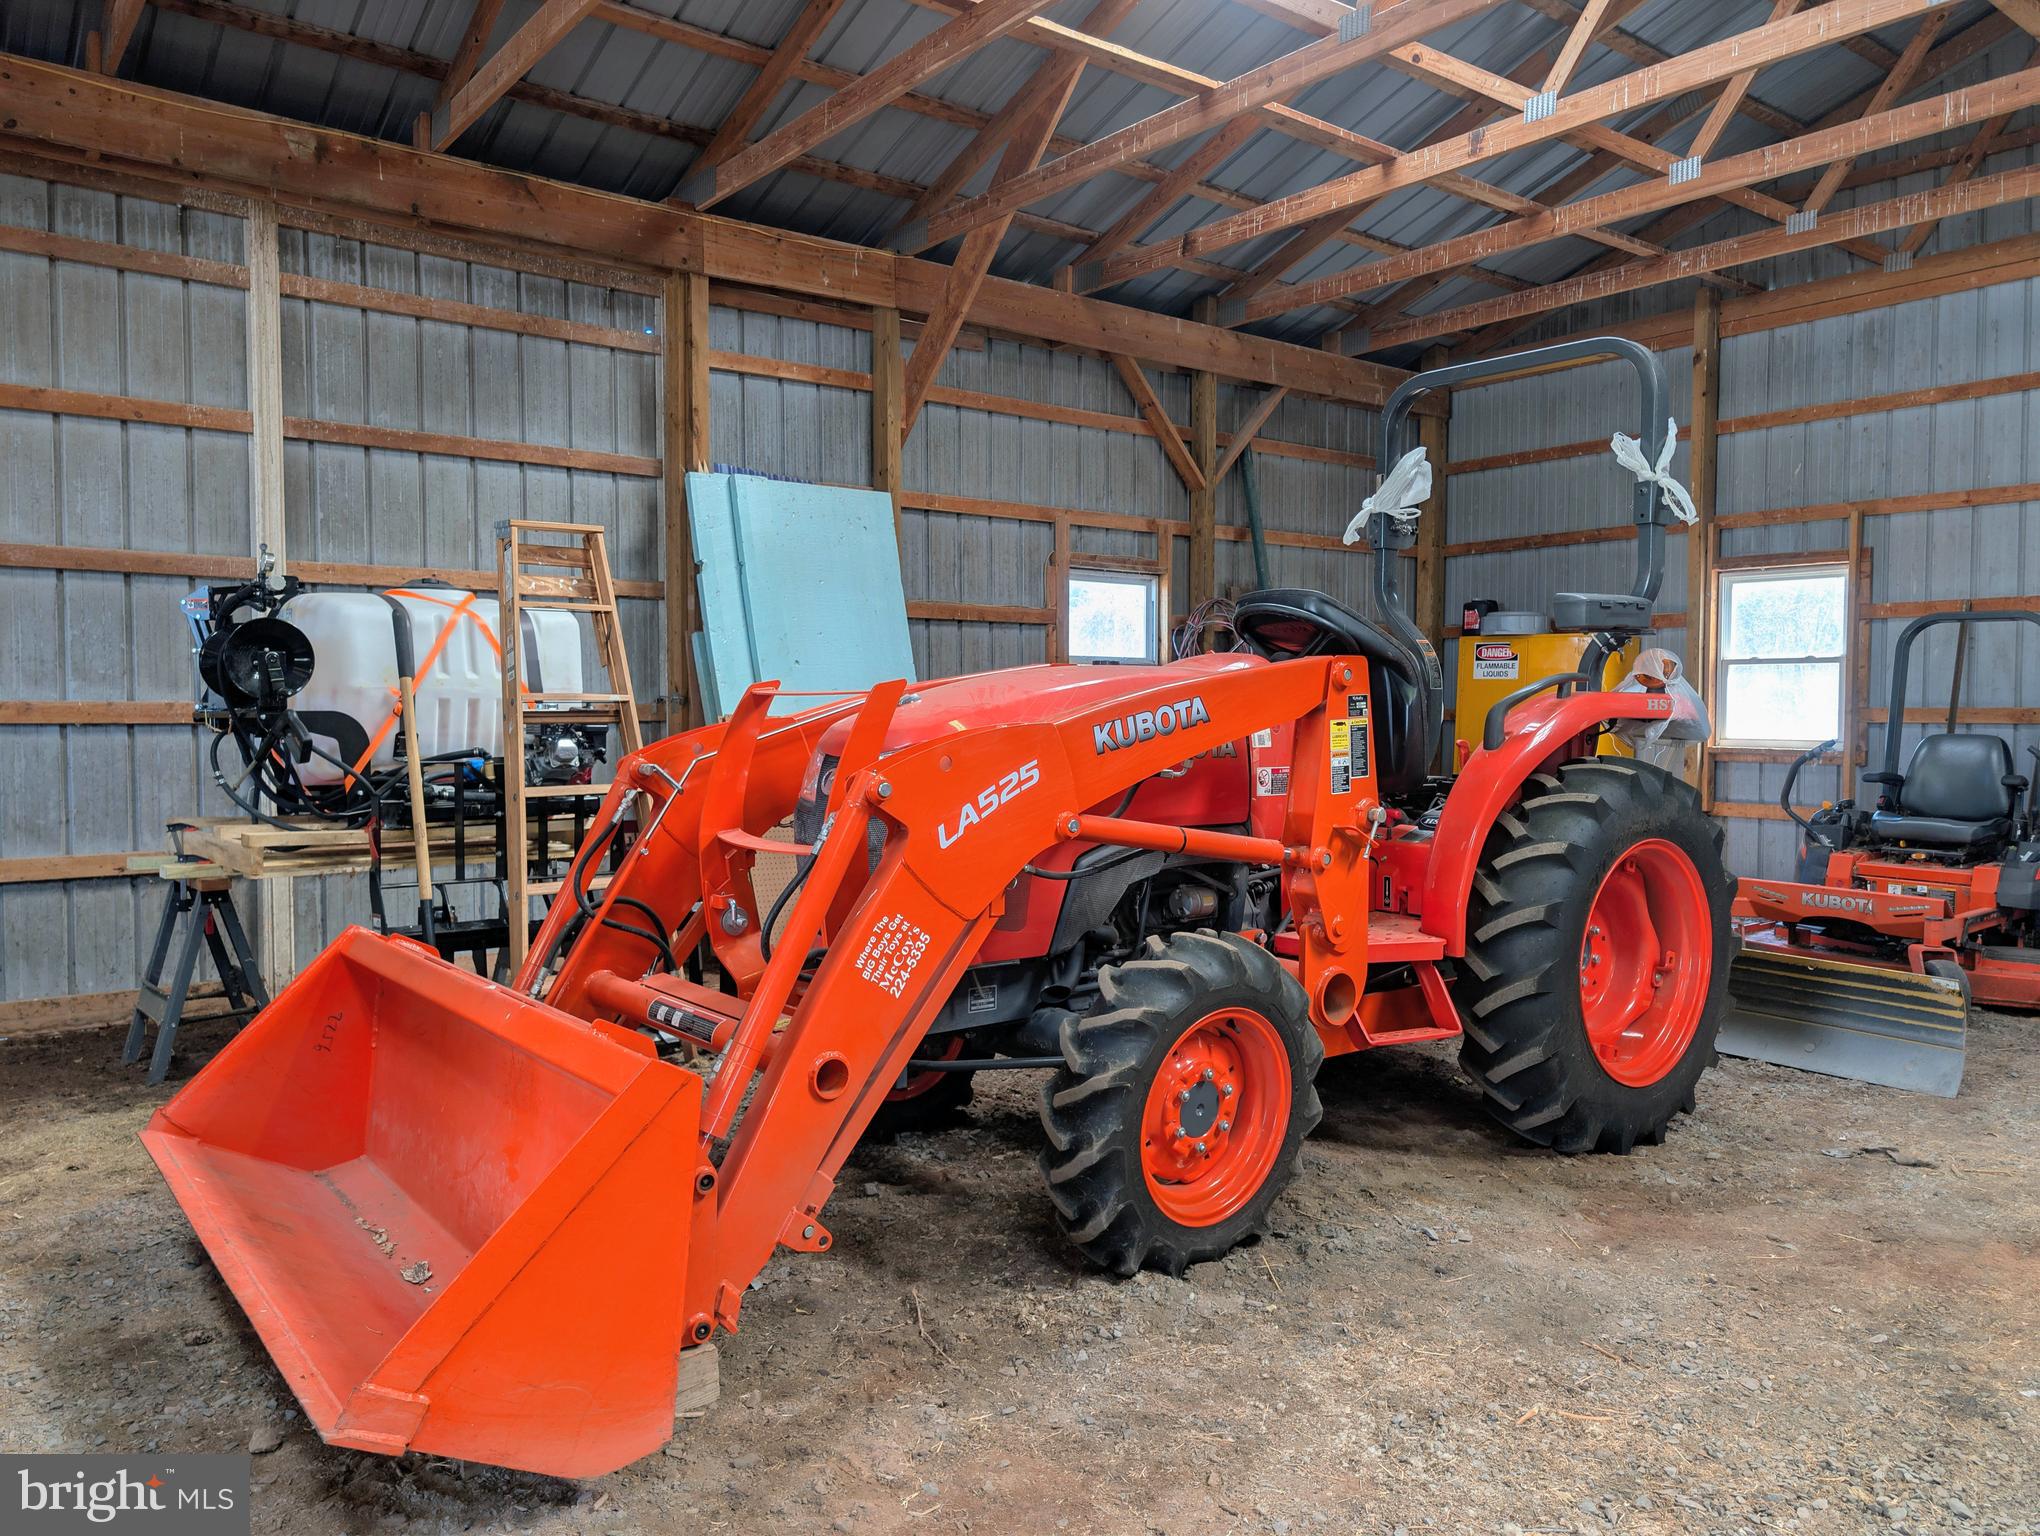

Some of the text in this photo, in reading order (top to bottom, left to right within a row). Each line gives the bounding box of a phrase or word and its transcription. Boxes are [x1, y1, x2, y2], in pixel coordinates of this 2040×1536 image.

[1476, 662, 1516, 670] FLAMMABLE
[1481, 647, 1513, 658] DANGER
[1092, 696, 1211, 755] KUBOTA
[937, 759, 1040, 849] LA525
[855, 916, 889, 969] Where The
[862, 914, 904, 980] BIG Boys Get
[870, 921, 911, 984] Their Toys at
[879, 926, 920, 991] McCoy's
[890, 932, 931, 999] 224-5335
